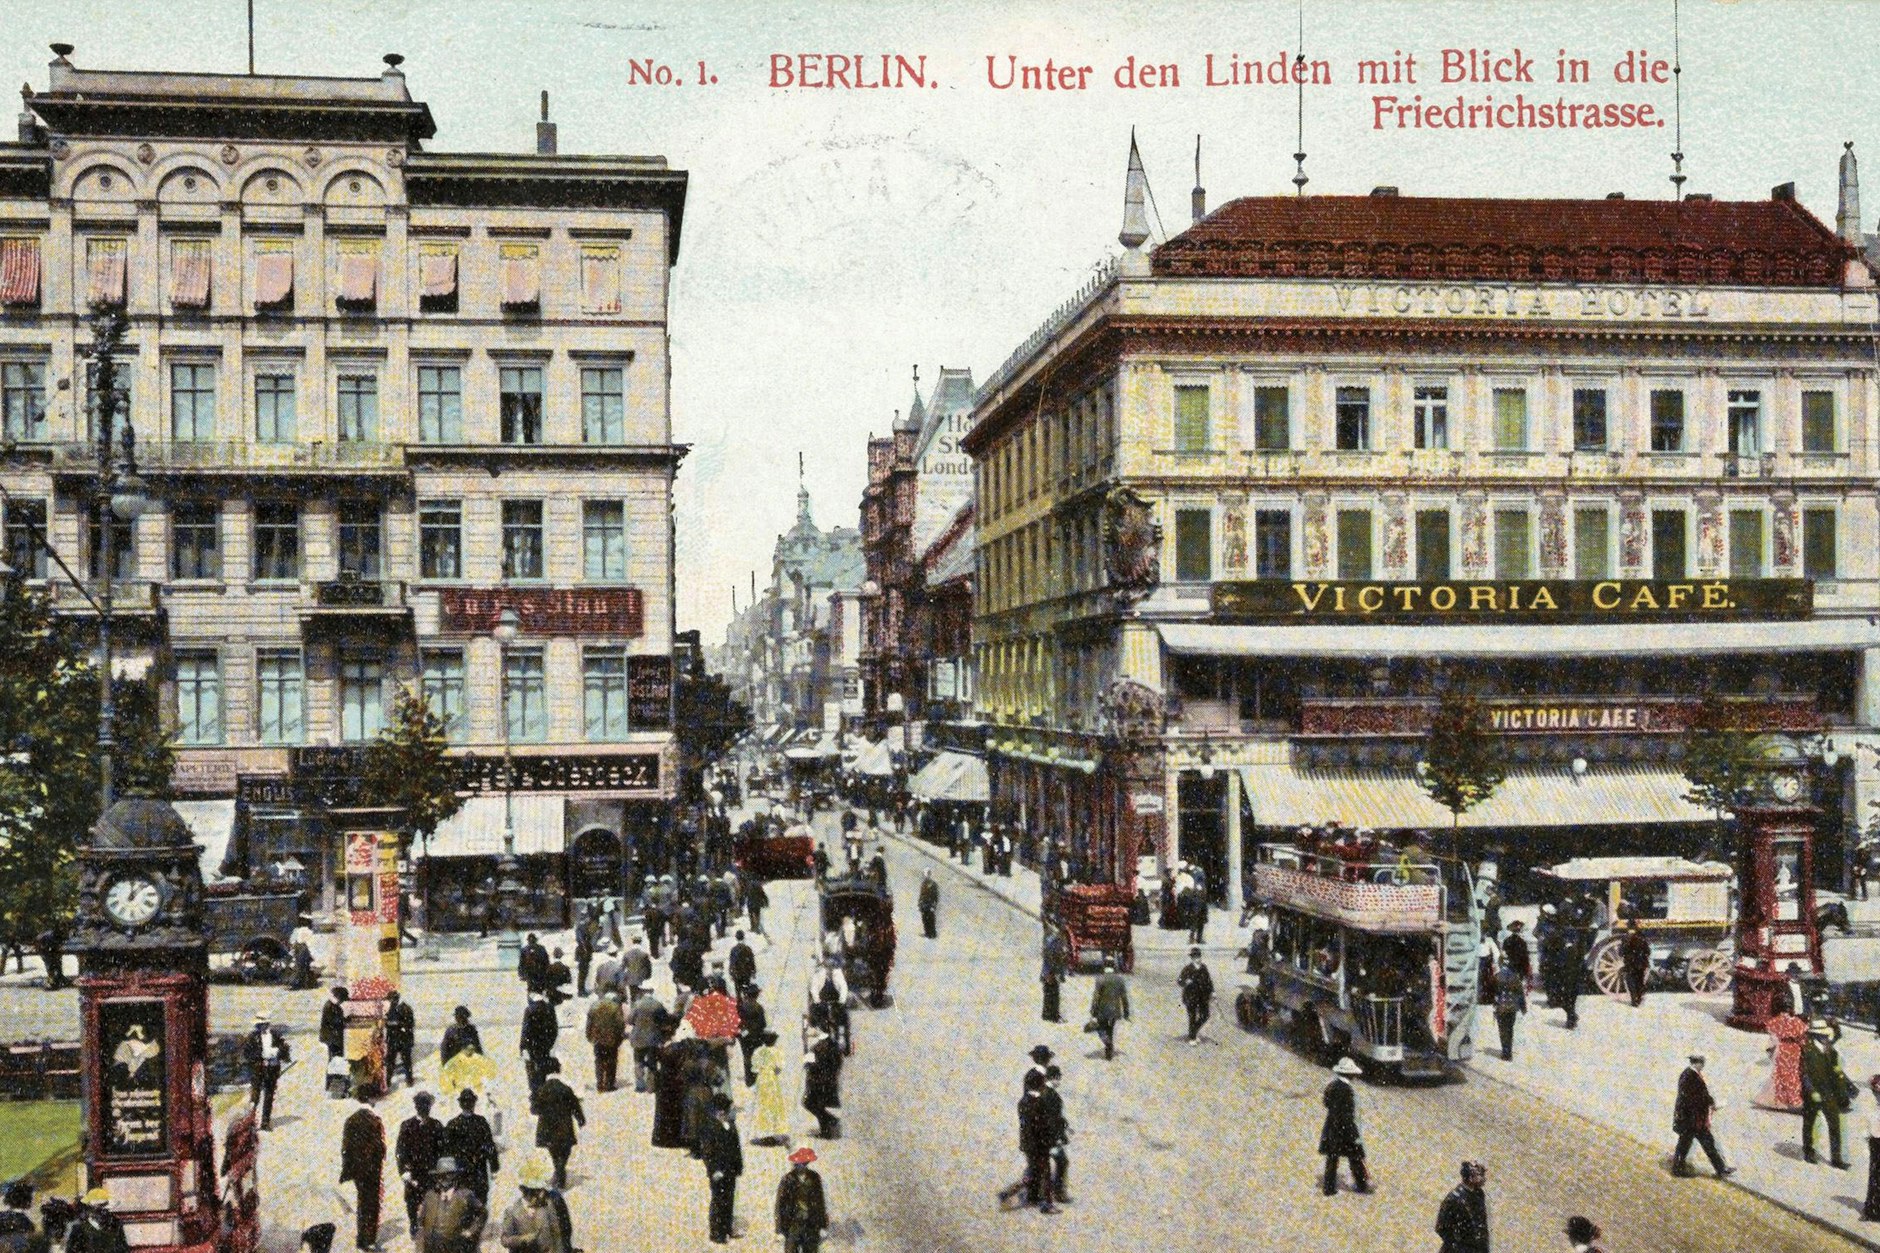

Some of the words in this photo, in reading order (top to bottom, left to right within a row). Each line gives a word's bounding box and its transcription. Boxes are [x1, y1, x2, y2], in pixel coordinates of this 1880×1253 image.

[1335, 286, 1551, 316] VICTORIA
[1580, 289, 1710, 317] HOTEL
[1293, 583, 1558, 612] VICTORIA
[1490, 708, 1580, 729] VICTORIA
